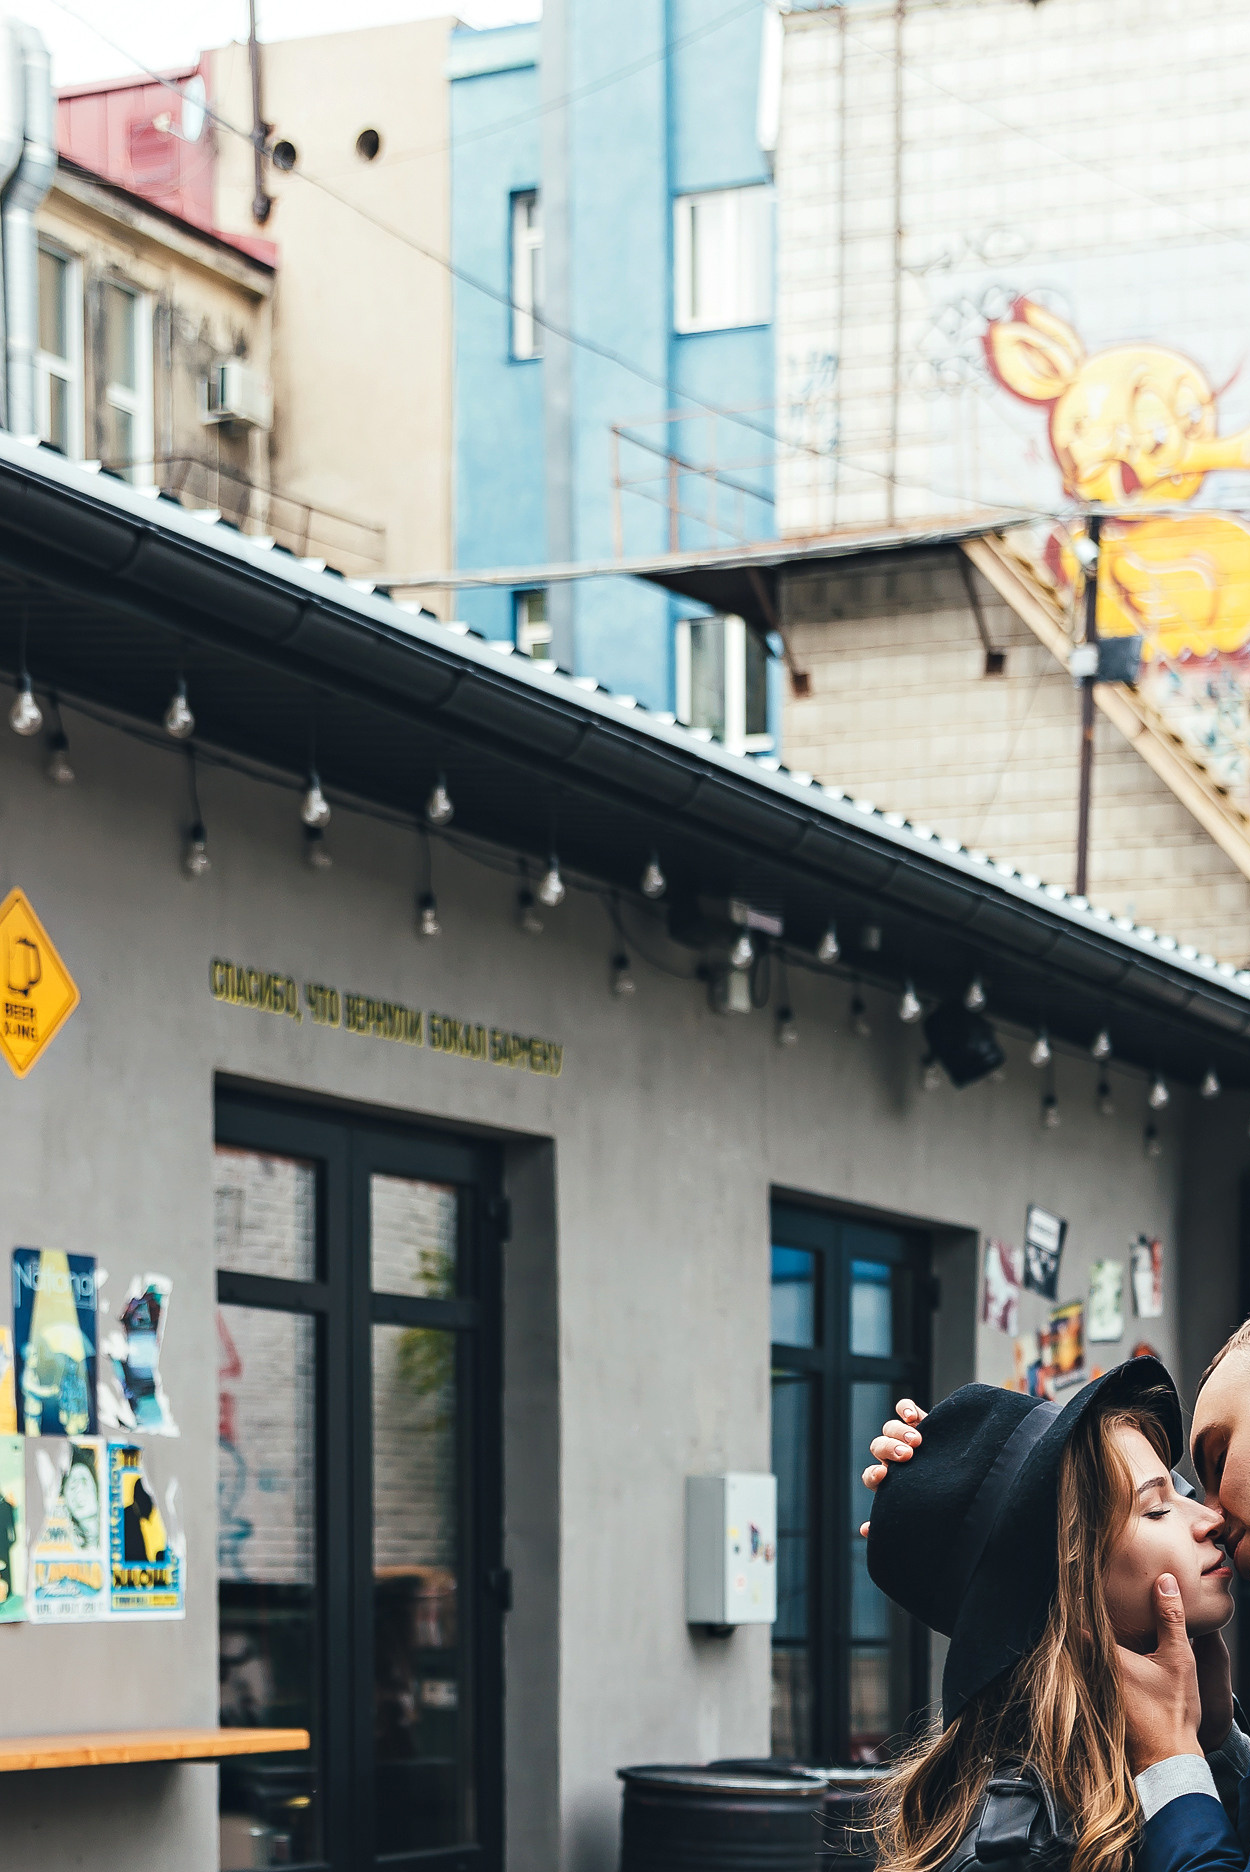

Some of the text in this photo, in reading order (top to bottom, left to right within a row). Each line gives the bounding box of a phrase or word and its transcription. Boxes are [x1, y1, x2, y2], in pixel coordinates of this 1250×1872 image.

[5, 1002, 37, 1023] BEER
[211, 957, 302, 1023] СПАСИБО,
[304, 982, 341, 1029] ЧТО
[428, 1009, 488, 1062] БОКАЛ
